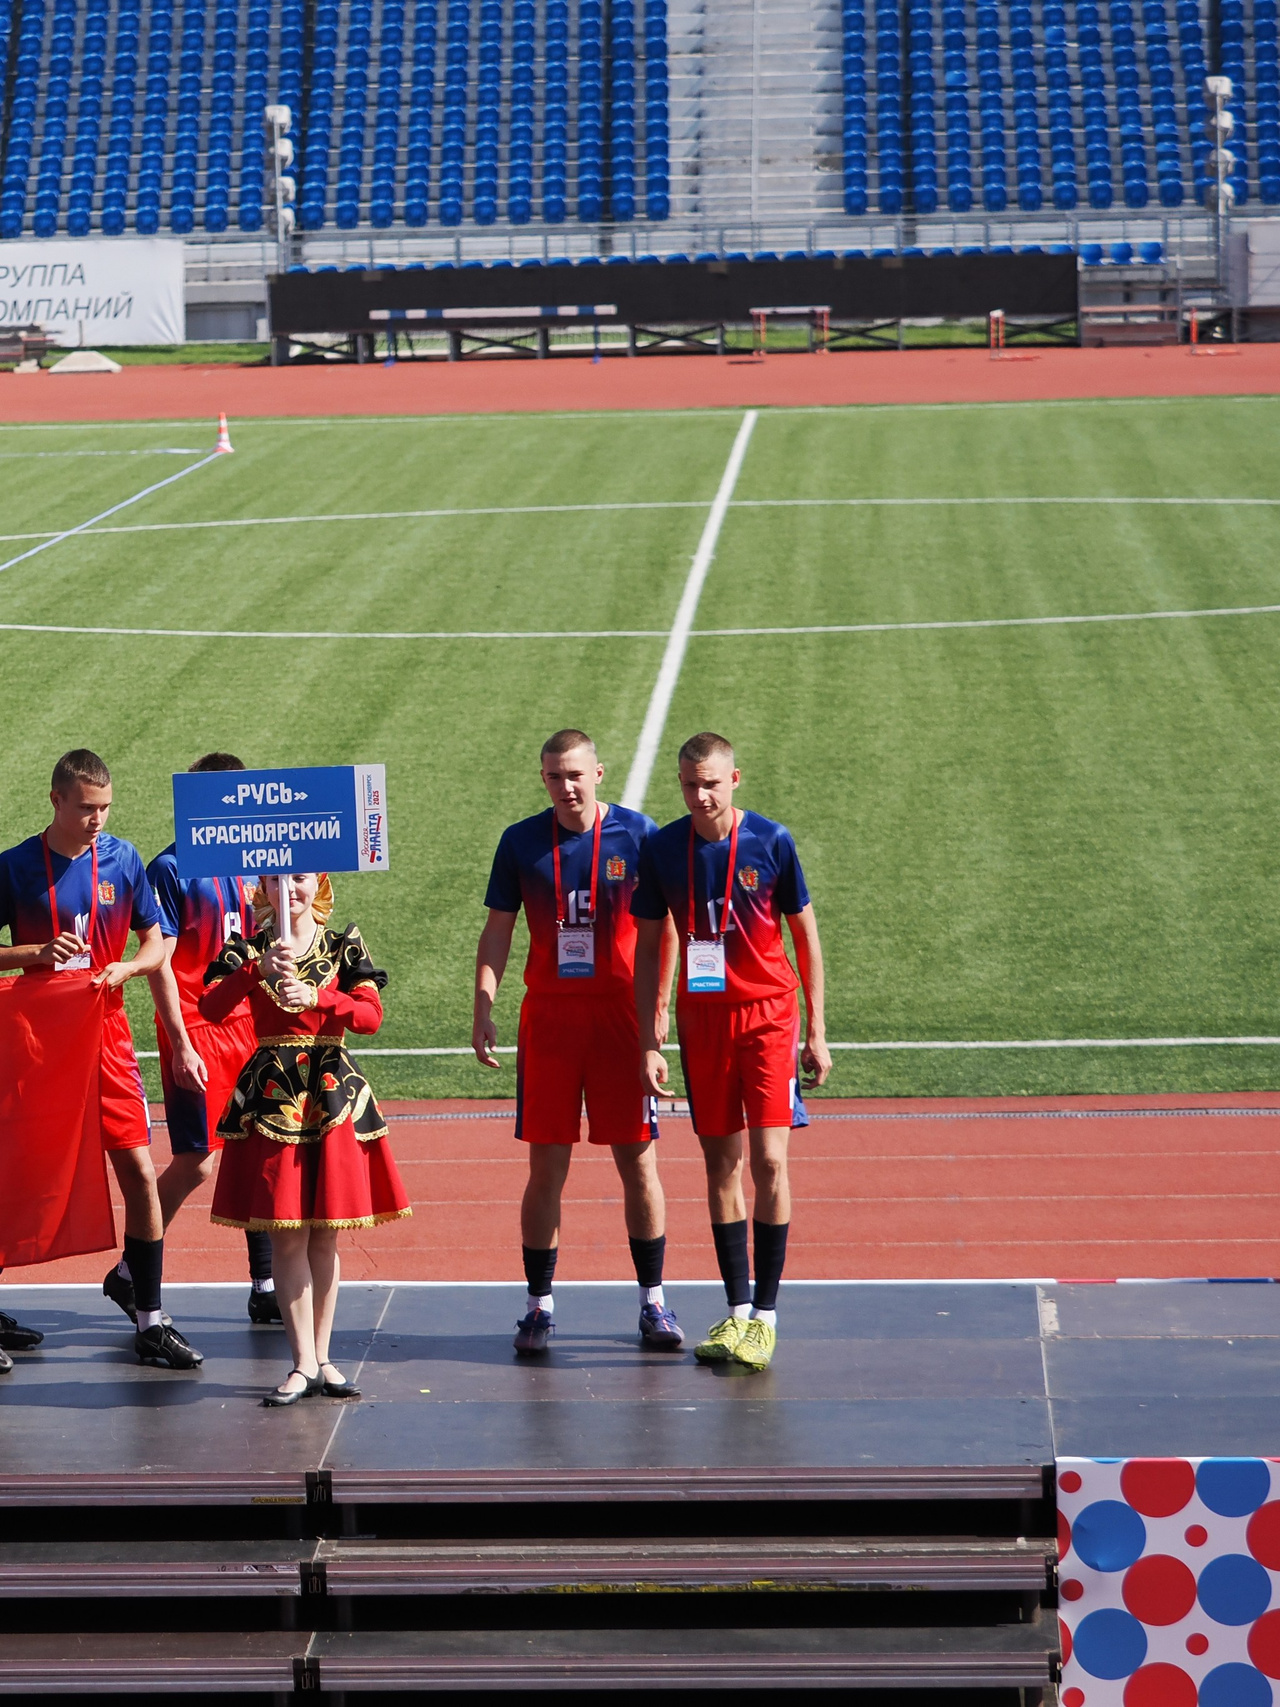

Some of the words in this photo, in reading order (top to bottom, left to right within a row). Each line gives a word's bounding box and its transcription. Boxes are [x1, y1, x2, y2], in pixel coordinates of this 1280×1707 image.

[221, 782, 308, 806] «РУСЬ»
[191, 816, 341, 846] КРАСНОЯРСКИЙ
[242, 844, 293, 869] КРАЙ
